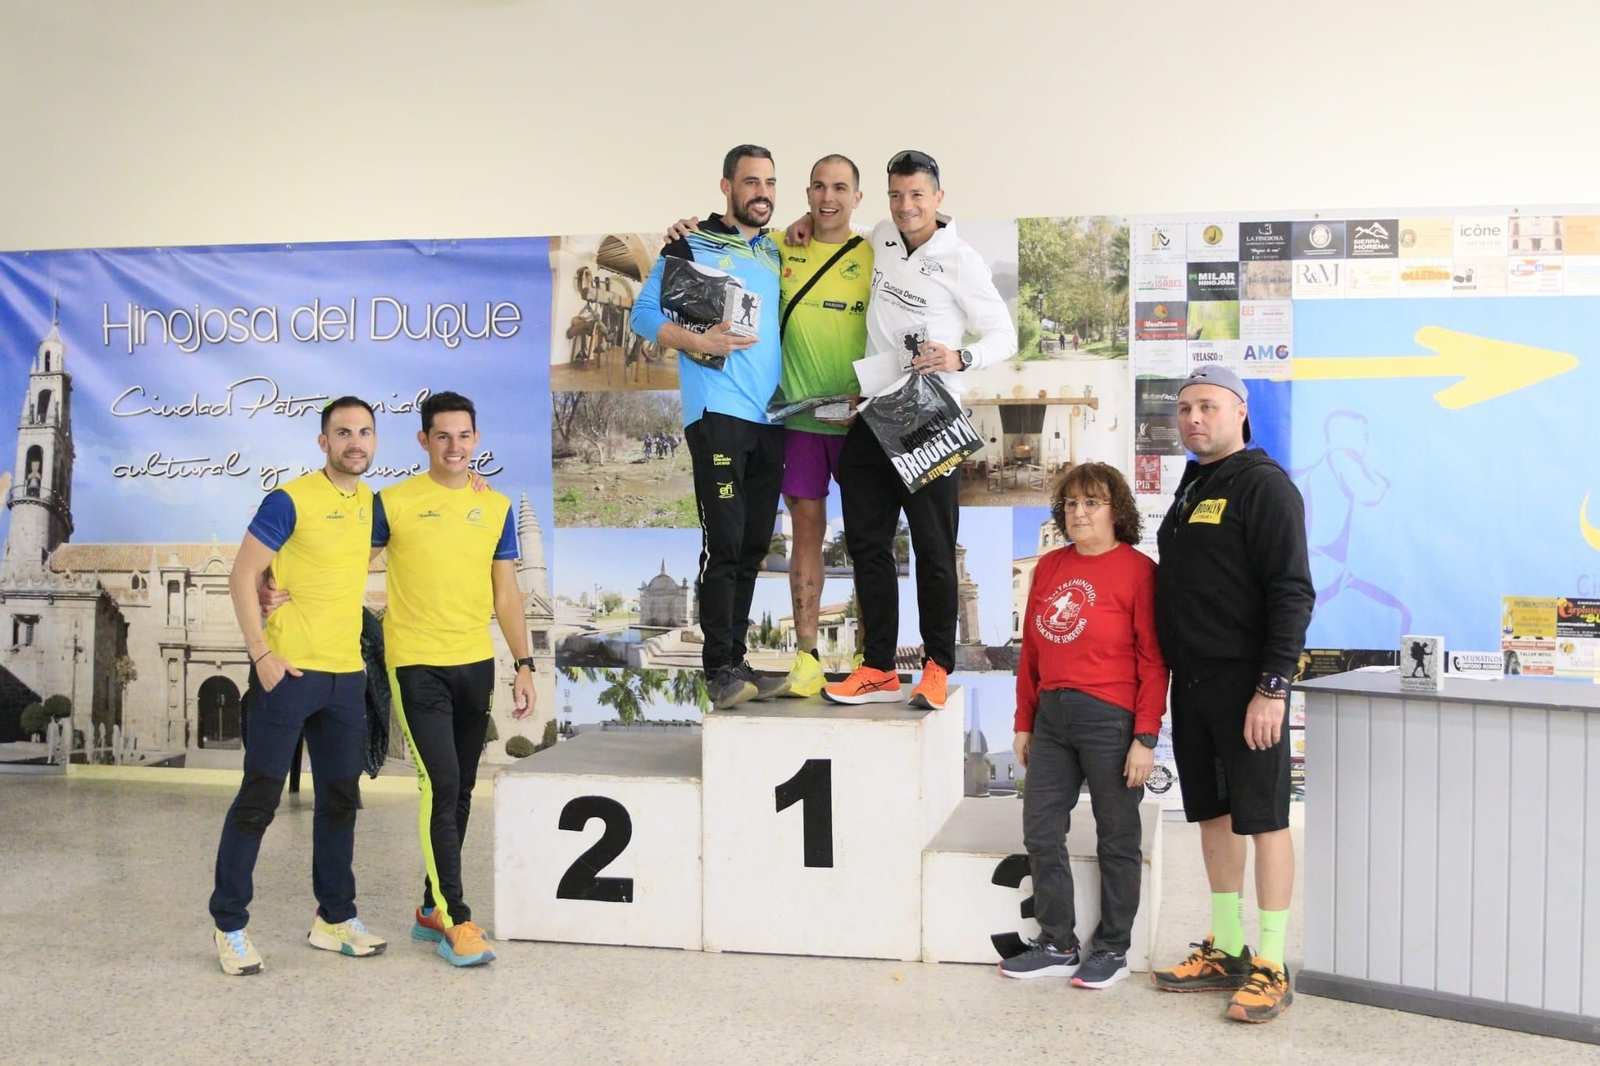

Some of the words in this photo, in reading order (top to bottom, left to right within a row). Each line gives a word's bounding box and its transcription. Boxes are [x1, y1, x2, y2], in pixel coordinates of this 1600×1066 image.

[1198, 272, 1236, 280] MILAR
[102, 300, 279, 354] Hinojosa
[290, 297, 356, 342] del
[370, 296, 522, 349] Duque
[1192, 352, 1218, 361] VELASCO
[1243, 344, 1289, 360] AMC
[110, 385, 233, 417] Ciudad
[891, 413, 978, 485] BROOKLYN
[112, 451, 251, 479] cultural
[259, 463, 289, 491] y
[775, 758, 834, 869] 1
[556, 795, 634, 904] 2
